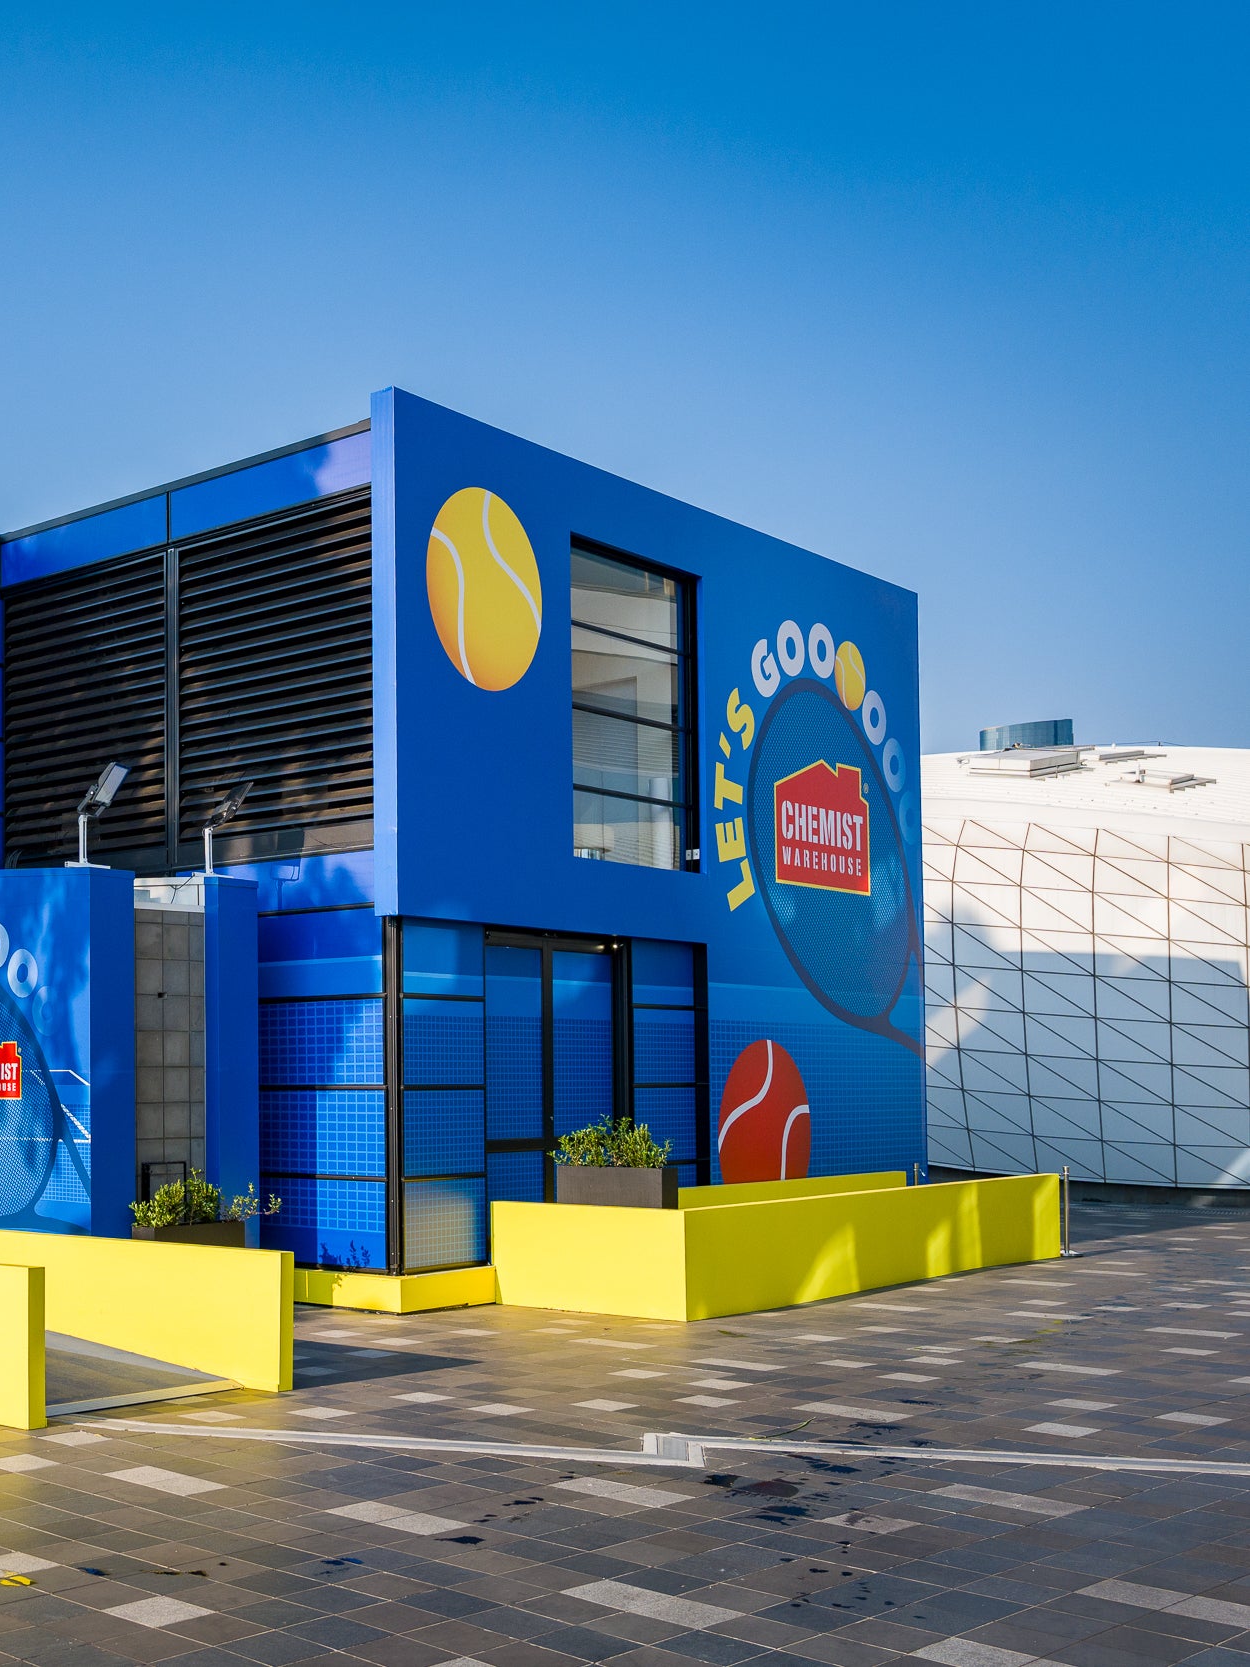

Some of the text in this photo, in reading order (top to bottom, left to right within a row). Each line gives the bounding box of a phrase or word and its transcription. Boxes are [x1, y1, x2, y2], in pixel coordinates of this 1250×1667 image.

[713, 687, 756, 912] LET'S
[781, 800, 864, 852] CHEMIST
[782, 845, 862, 877] WAREHOUSE
